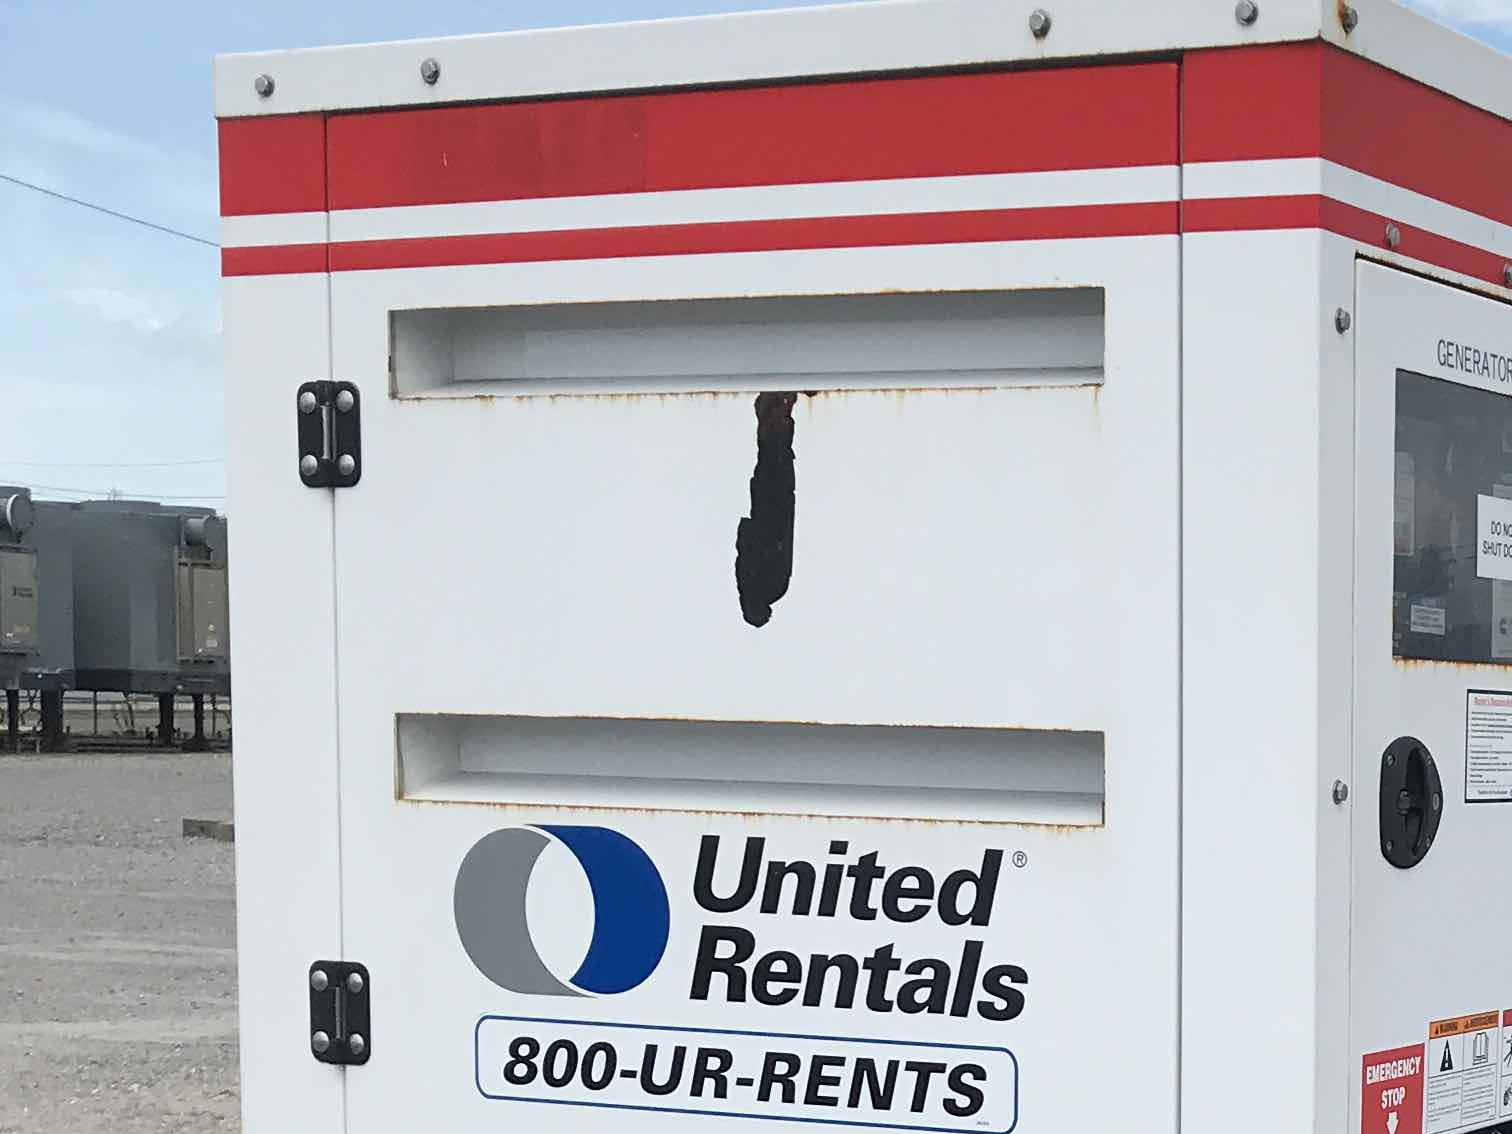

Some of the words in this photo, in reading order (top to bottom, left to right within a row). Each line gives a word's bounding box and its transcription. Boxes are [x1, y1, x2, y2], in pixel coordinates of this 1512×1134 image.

[1490, 520, 1502, 536] DO
[1482, 540, 1502, 557] SHUT
[693, 835, 1004, 927] United
[689, 924, 1029, 1022] Rentals
[502, 1036, 989, 1118] 800-UR-RENTS
[1366, 1055, 1422, 1085] EMERGENCY
[1381, 1086, 1406, 1109] STOP
